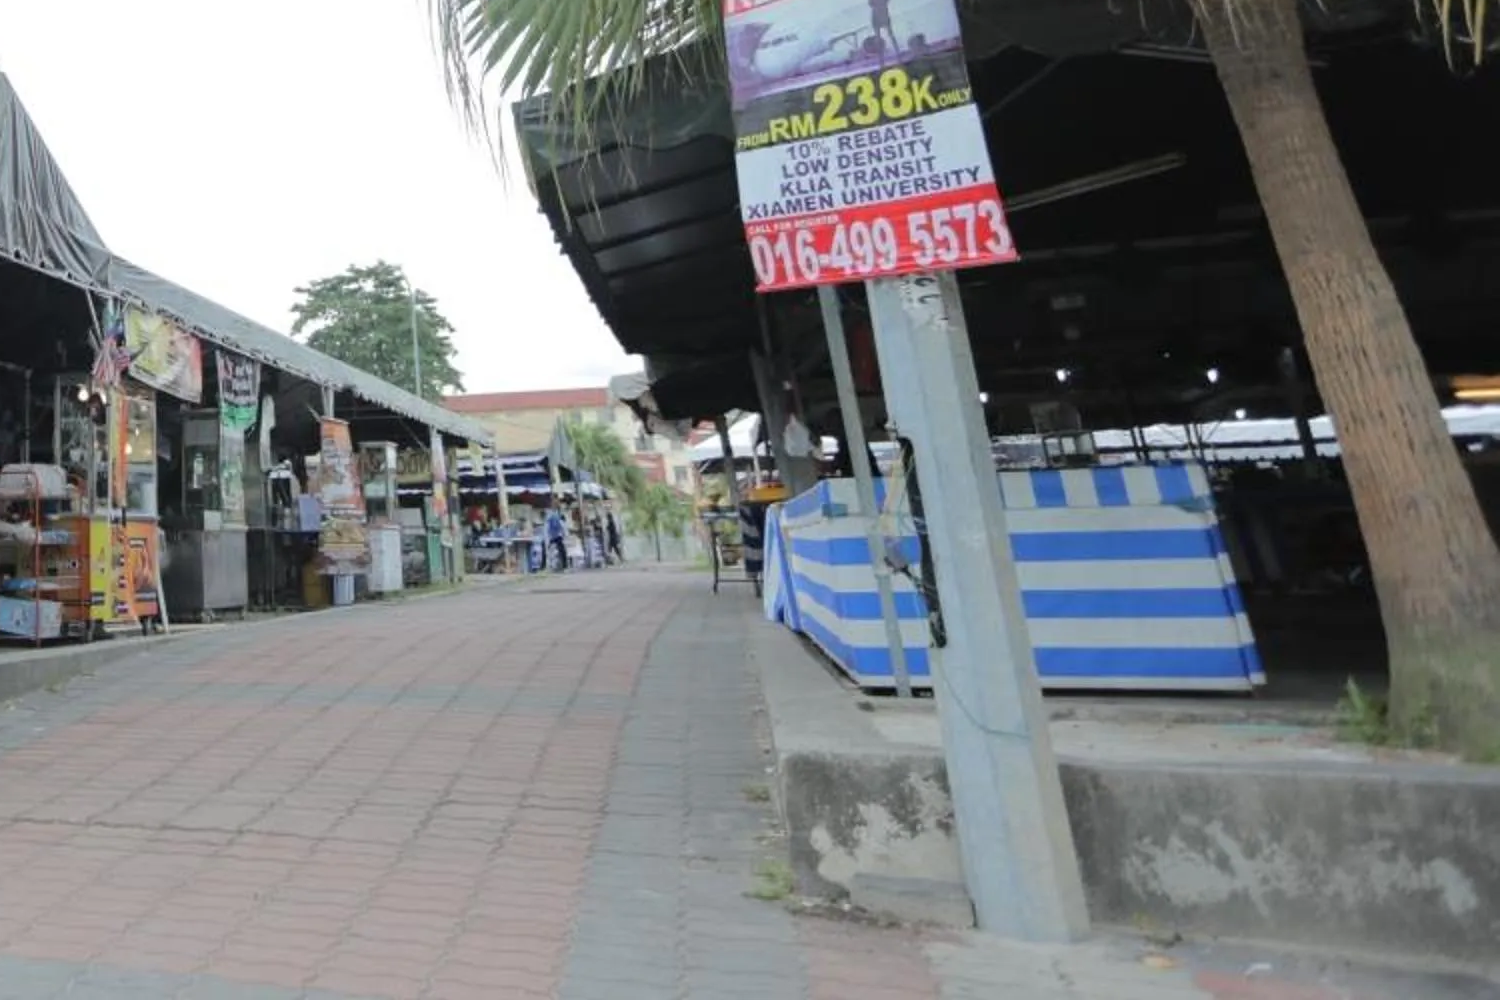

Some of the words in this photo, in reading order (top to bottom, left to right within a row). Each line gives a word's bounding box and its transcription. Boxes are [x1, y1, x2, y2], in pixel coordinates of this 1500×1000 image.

[938, 87, 972, 107] ONLY
[781, 158, 829, 179] LOW
[838, 136, 933, 170] DENSITY
[787, 139, 831, 161] 10%
[838, 120, 927, 152] REBATE
[747, 193, 834, 220] XIAMEN
[842, 165, 981, 205] UNIVERSITY
[779, 176, 833, 198] KLIA
[837, 156, 937, 188] TRANSIT
[749, 217, 898, 286] 016-499
[907, 199, 1013, 265] 5573
